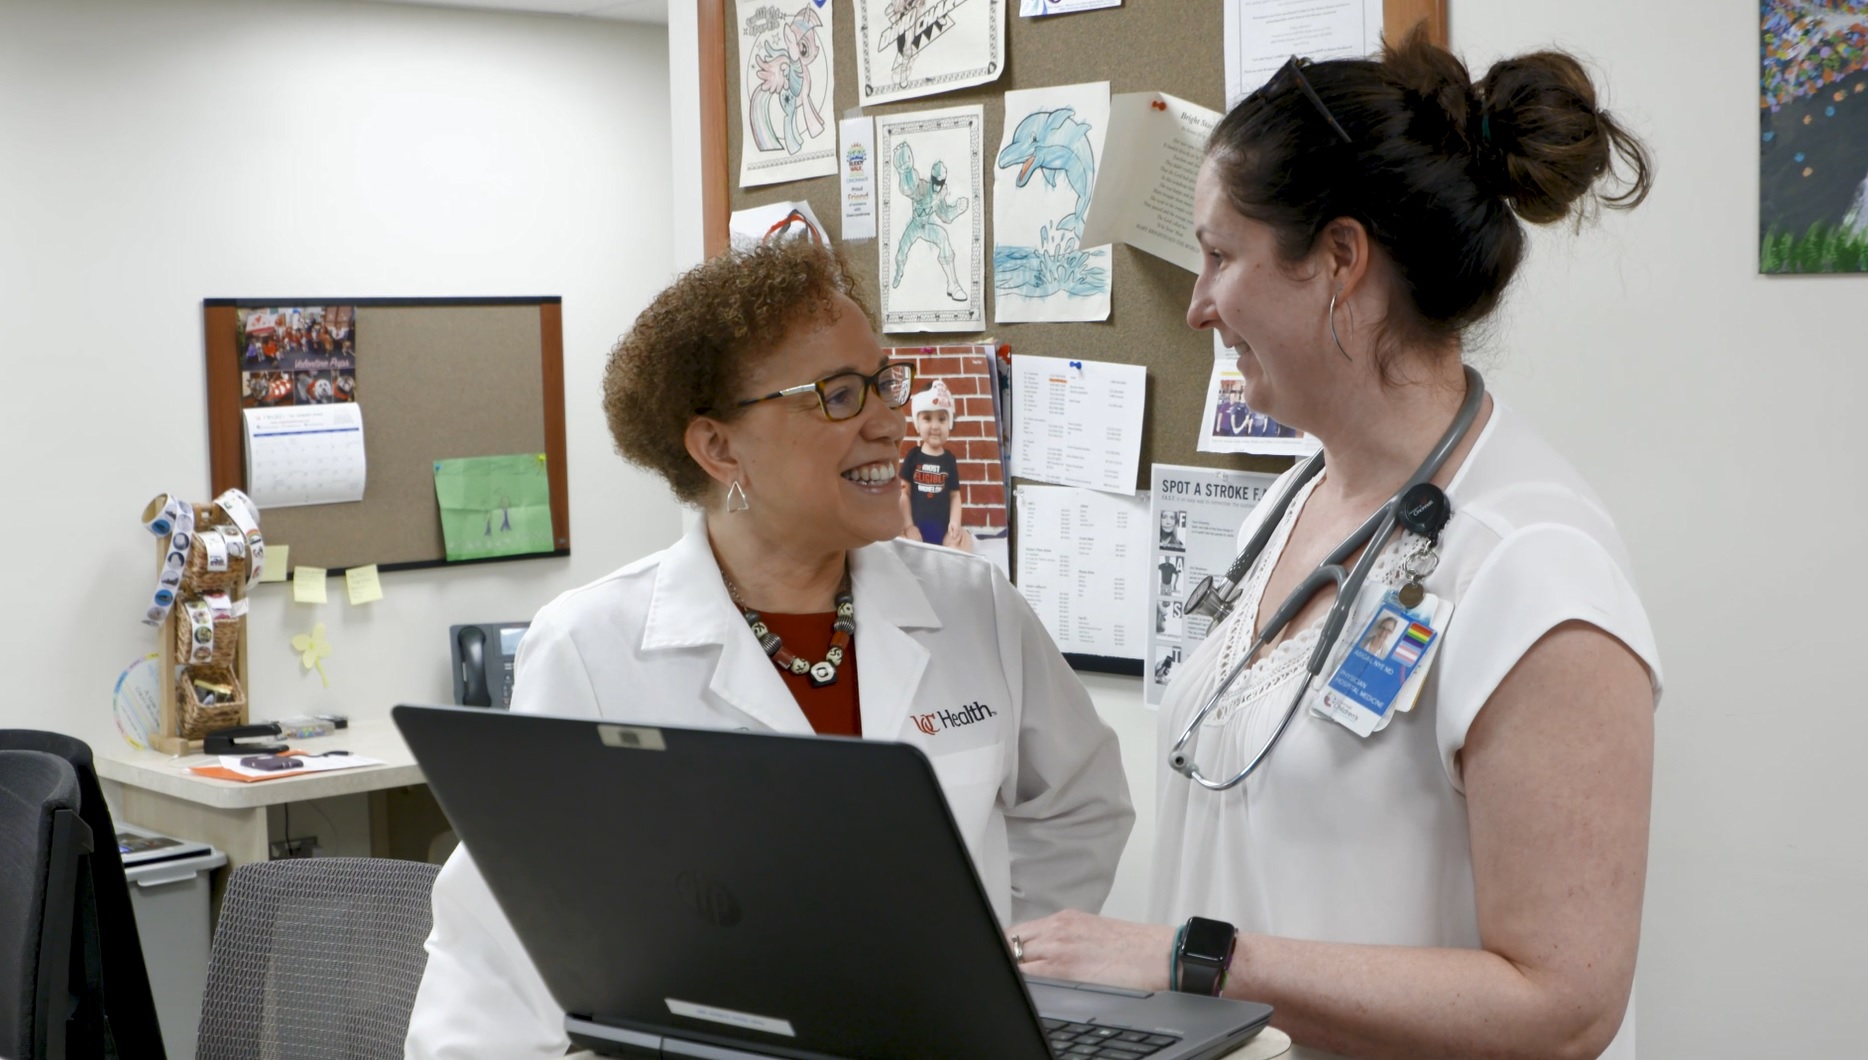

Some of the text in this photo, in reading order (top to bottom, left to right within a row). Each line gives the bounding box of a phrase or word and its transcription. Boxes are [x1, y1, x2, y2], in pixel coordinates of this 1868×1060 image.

[1180, 111, 1213, 130] Bright Star
[294, 358, 329, 369] Valentine
[922, 464, 940, 473] MOST
[1162, 479, 1190, 495] SPOT
[1194, 482, 1202, 496] A
[1205, 483, 1249, 500] STROKE
[1174, 602, 1182, 618] S
[1340, 669, 1368, 689] PHYSICIAN
[1384, 666, 1394, 676] MD
[1336, 676, 1359, 695] HOSPITAL
[1360, 690, 1384, 708] MEDICINE
[910, 701, 993, 736] UC Health
